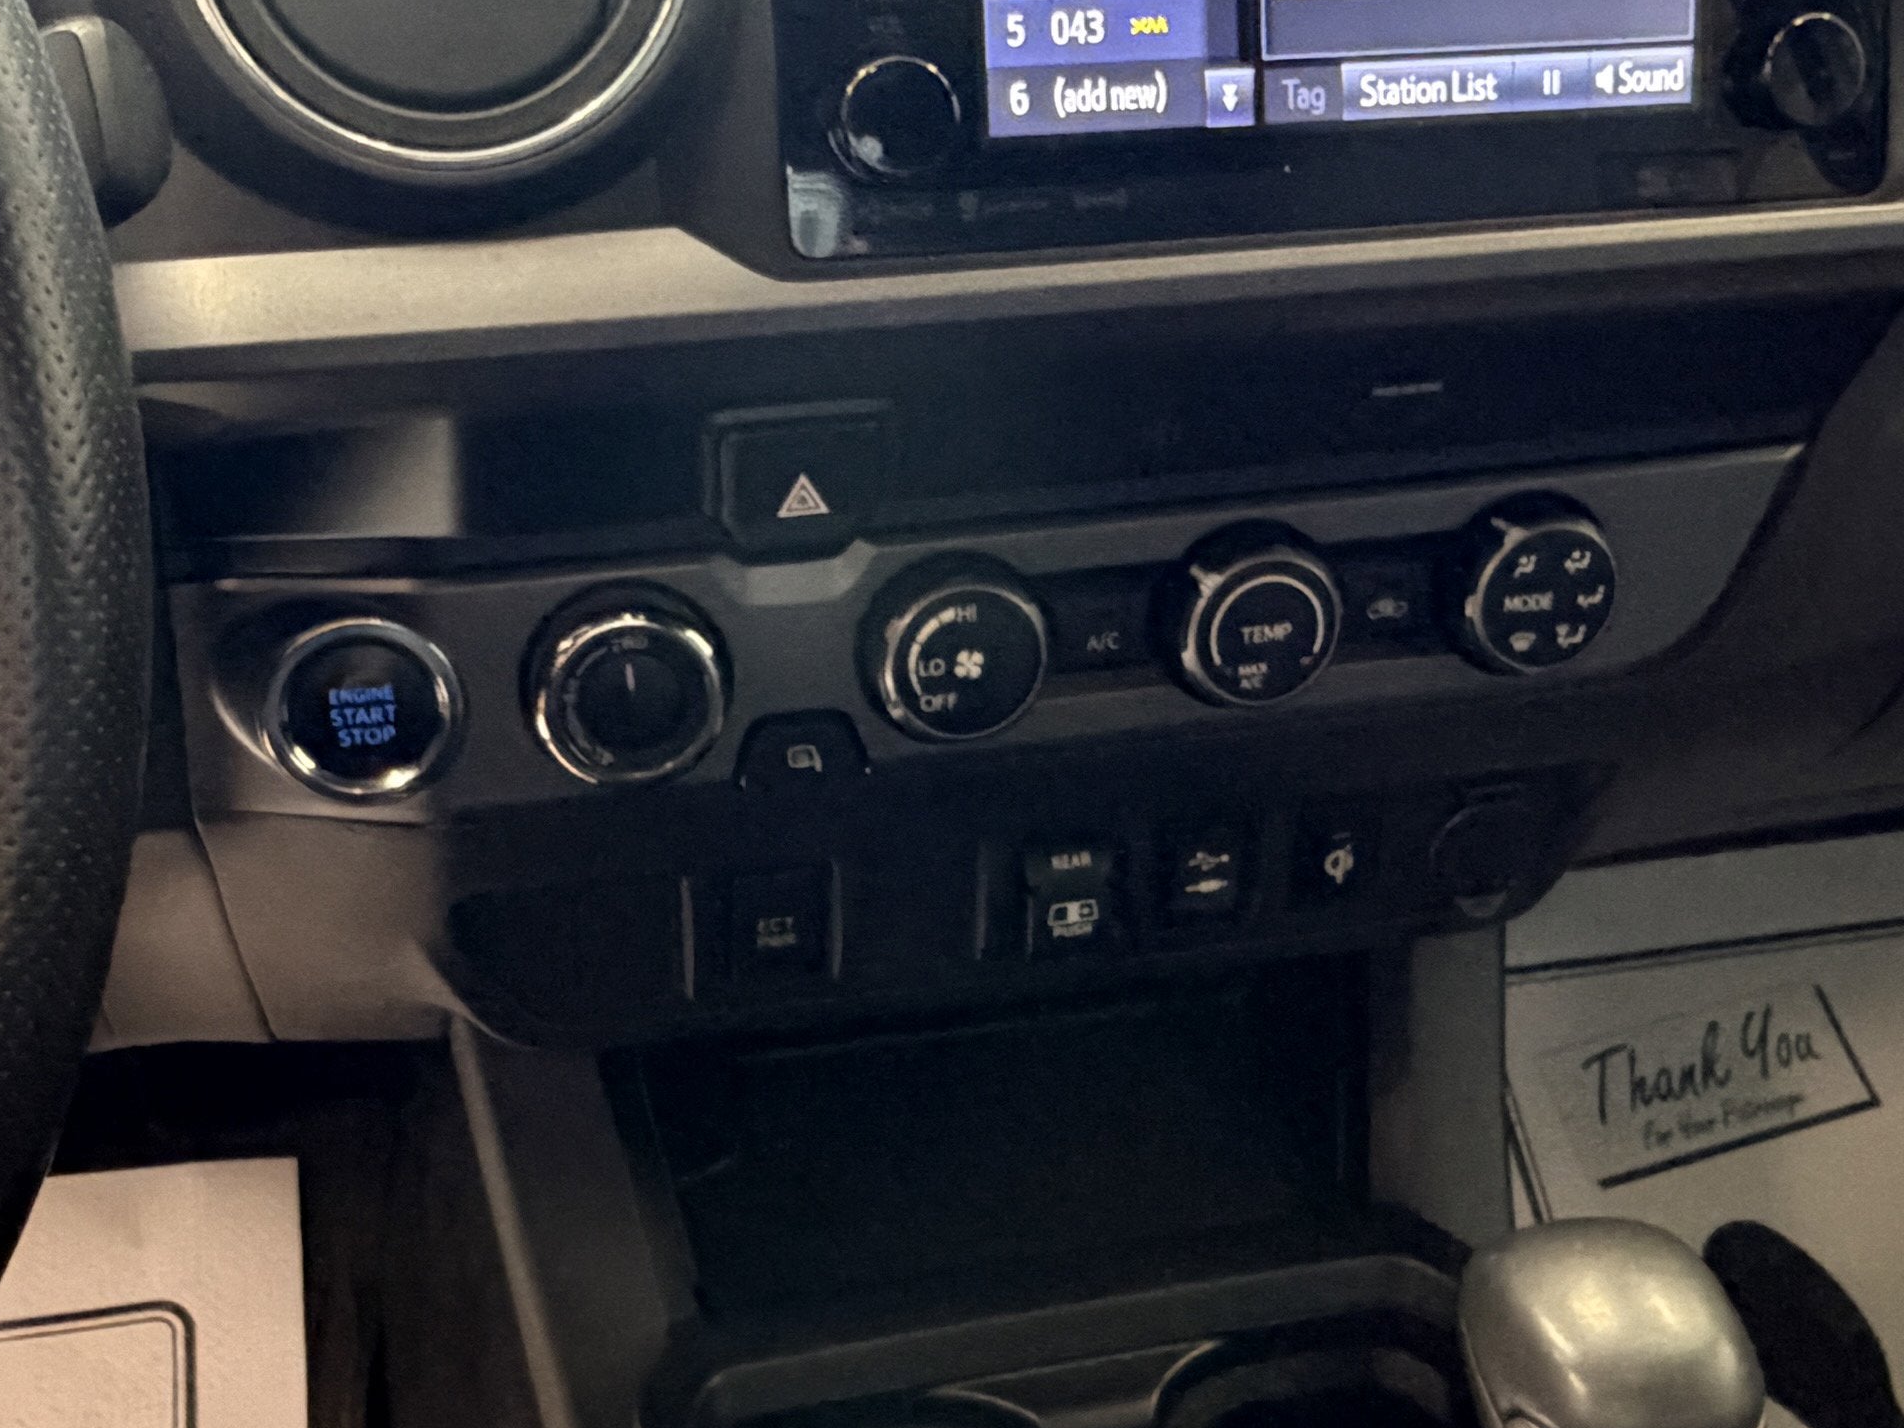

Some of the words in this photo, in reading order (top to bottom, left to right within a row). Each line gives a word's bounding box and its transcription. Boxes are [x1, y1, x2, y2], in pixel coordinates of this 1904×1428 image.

[1006, 12, 1026, 48] 5
[1050, 8, 1105, 46] 043
[1009, 79, 1030, 116] 6
[1053, 75, 1107, 119] (add
[1109, 69, 1168, 114] new)
[1281, 76, 1326, 116] Tag
[1358, 72, 1446, 107] Station
[1450, 69, 1499, 103] List
[1617, 58, 1685, 95] Sound
[918, 658, 946, 678] LO
[329, 704, 396, 727] START
[338, 724, 396, 748] STOP
[1581, 1020, 1731, 1125] Thank
[1739, 1002, 1822, 1080] You
